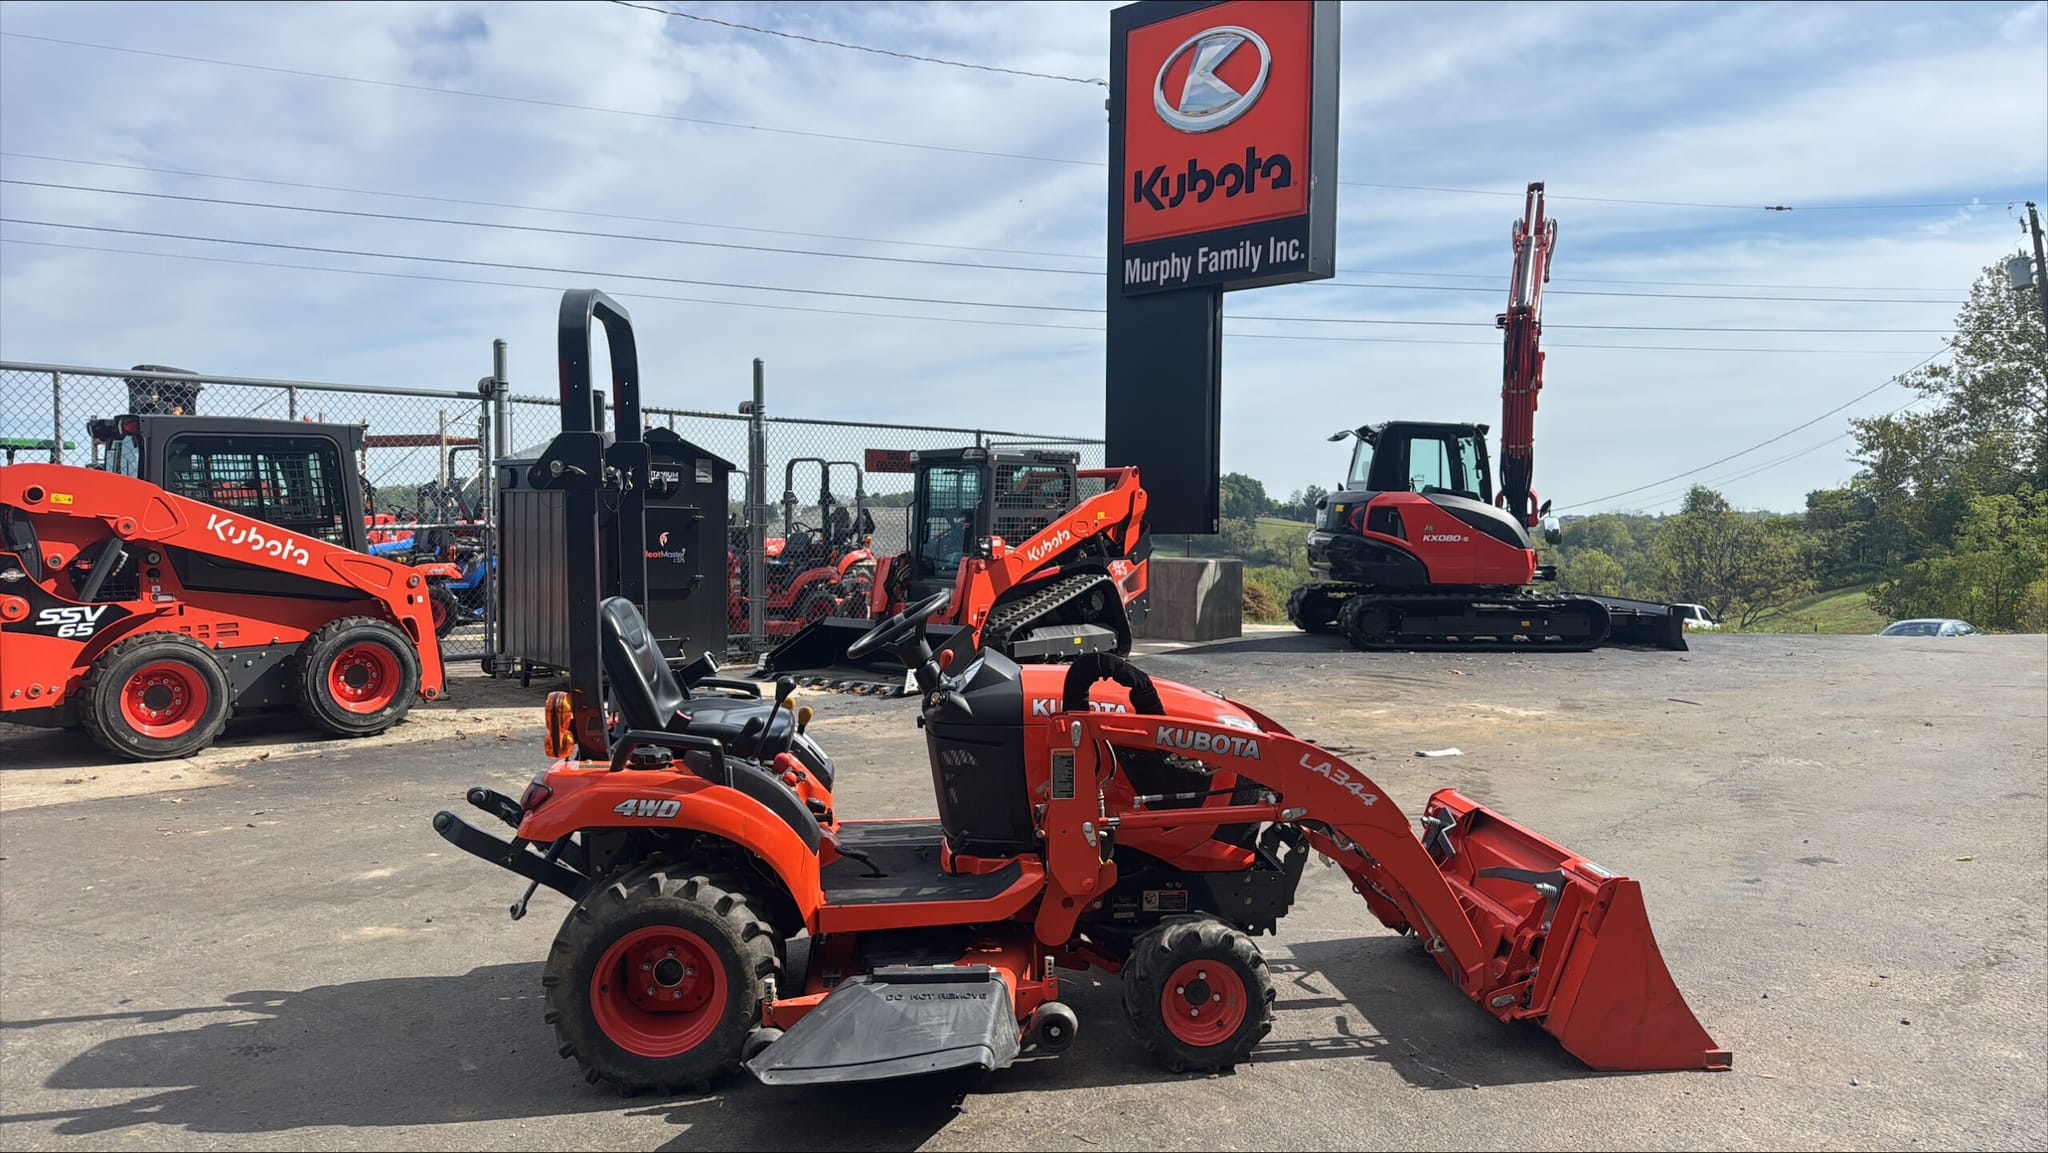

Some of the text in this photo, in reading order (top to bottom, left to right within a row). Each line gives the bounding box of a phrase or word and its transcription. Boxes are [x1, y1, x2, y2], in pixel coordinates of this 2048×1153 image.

[1133, 145, 1292, 212] Kubota
[1124, 236, 1305, 286] Murphy Family Inc.
[207, 513, 309, 566] Kubota
[1027, 529, 1071, 561] Kubota
[35, 604, 108, 626] SSV
[57, 622, 95, 638] 65
[1032, 698, 1128, 717] KUOTA
[1155, 725, 1261, 760] KUBOTA
[1299, 752, 1379, 806] LA344
[612, 798, 682, 818] 4WD
[910, 993, 935, 1001] NOT
[937, 992, 987, 1001] REMOVE
